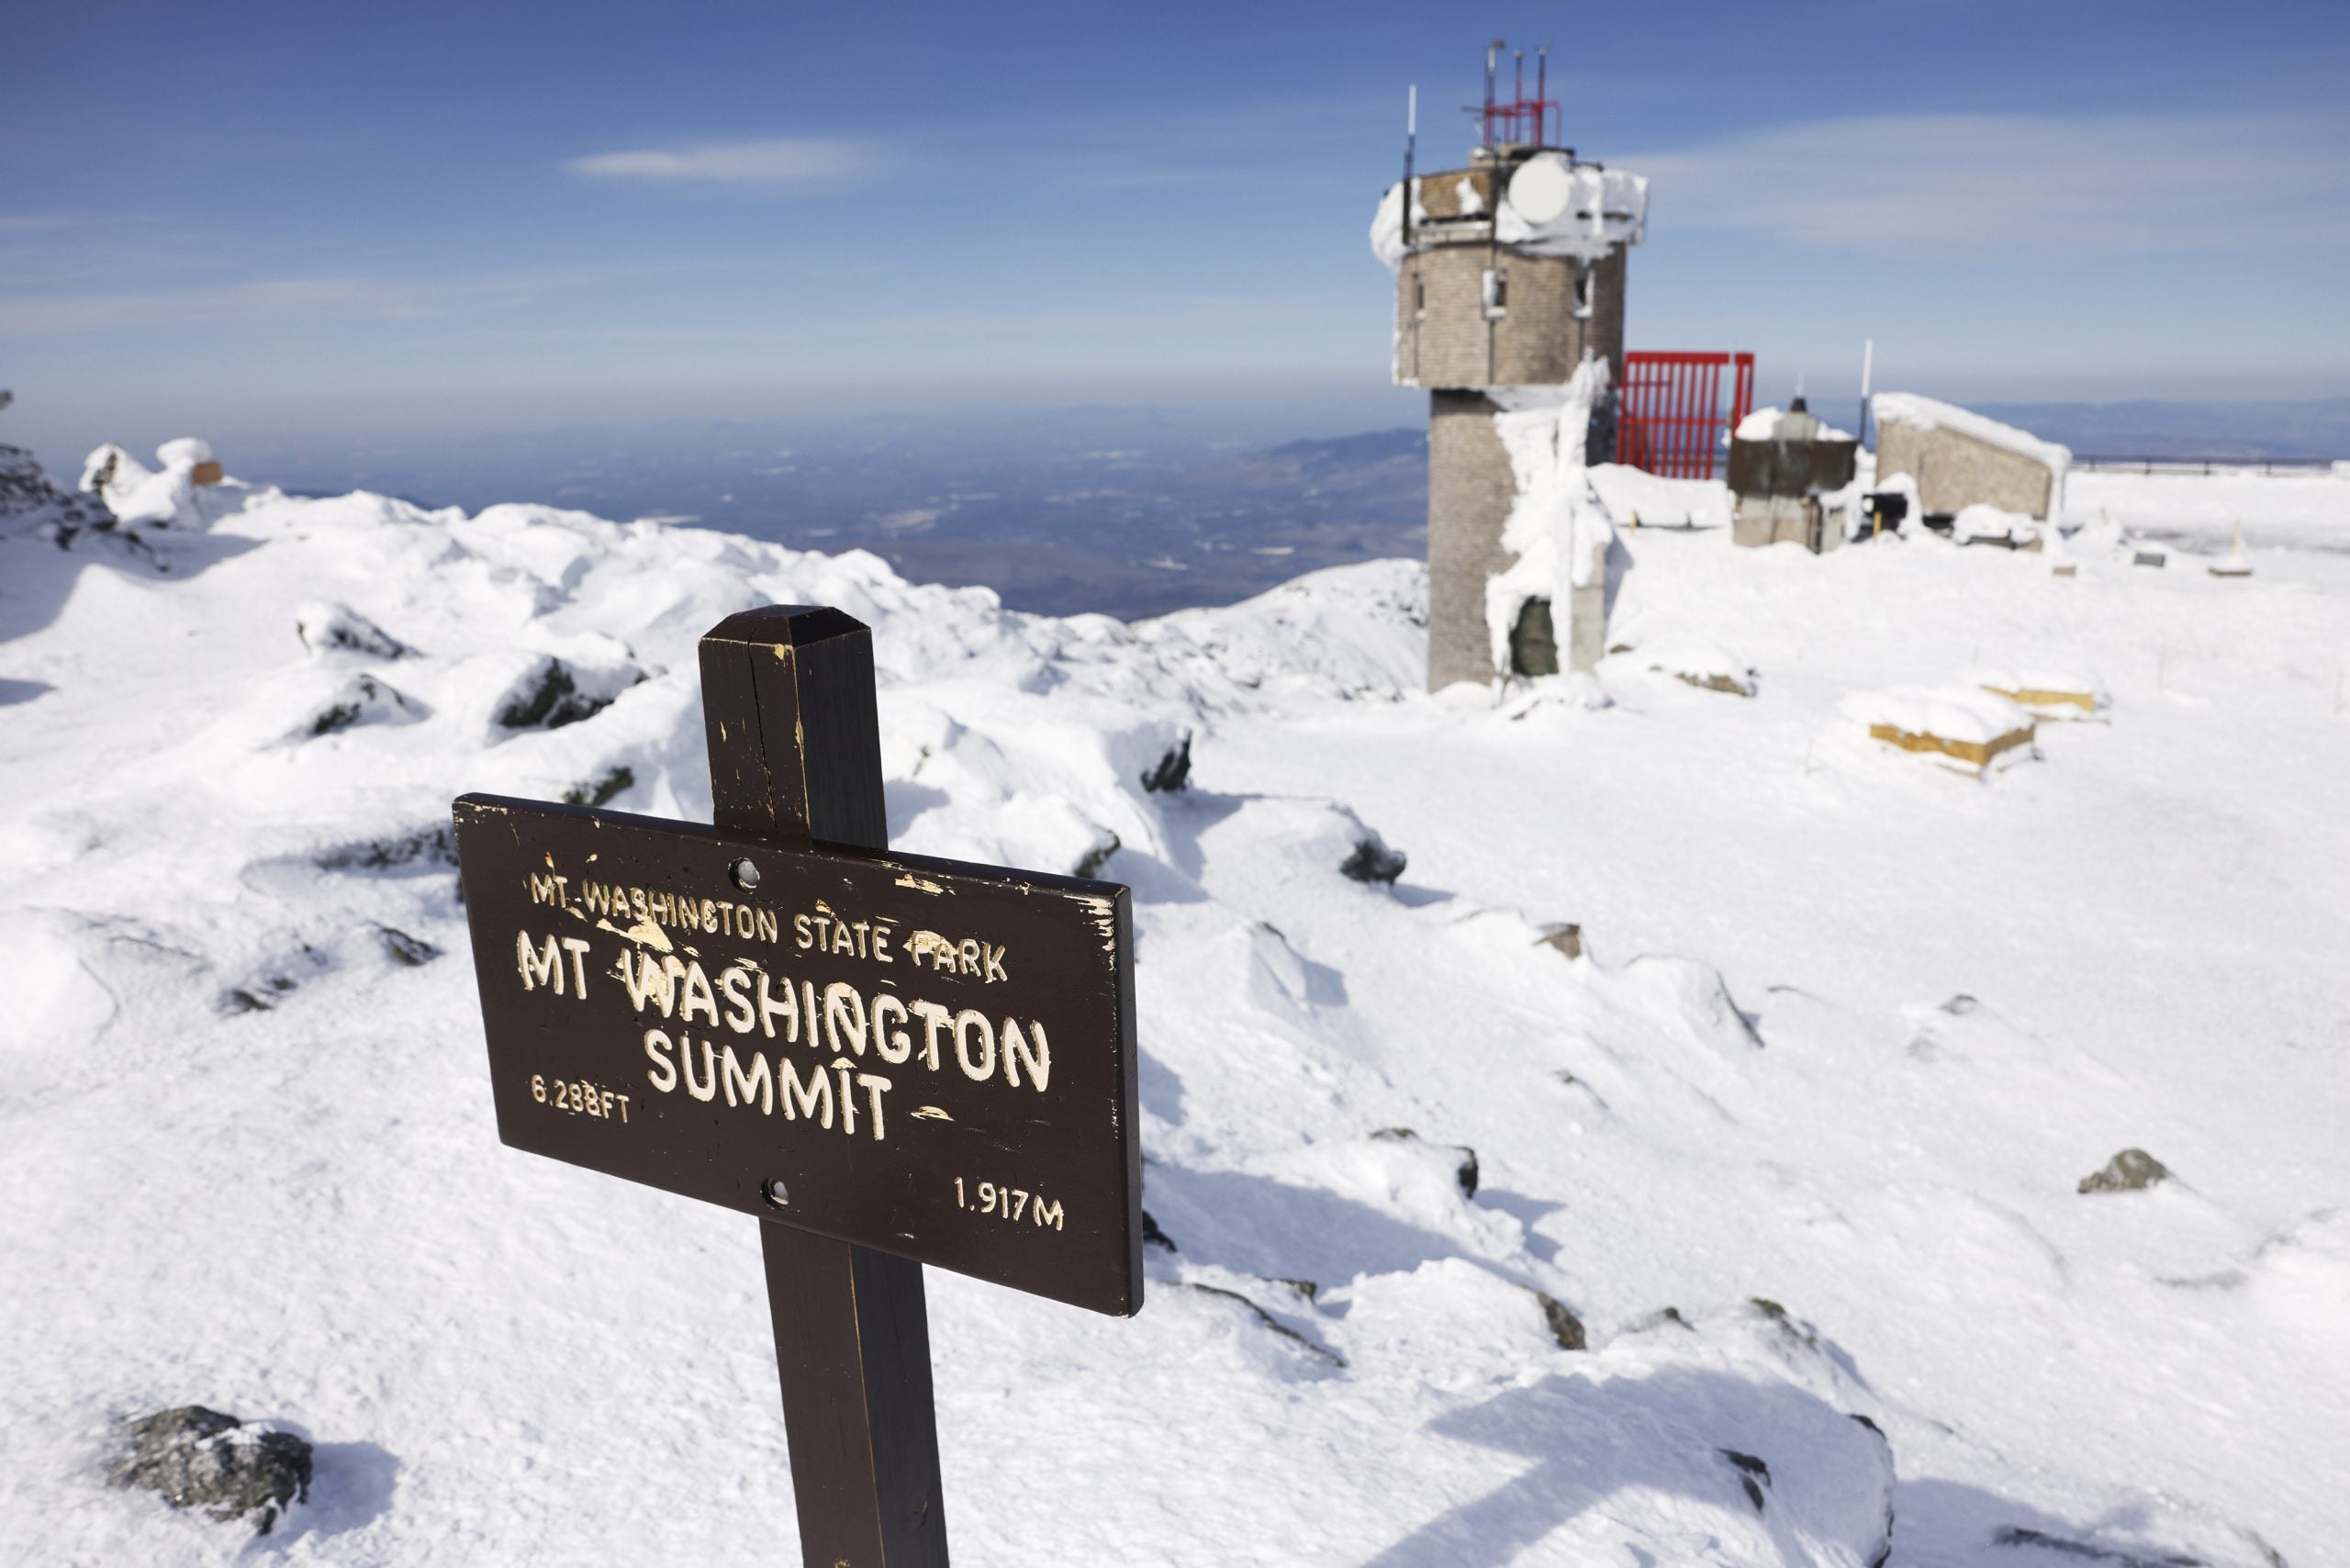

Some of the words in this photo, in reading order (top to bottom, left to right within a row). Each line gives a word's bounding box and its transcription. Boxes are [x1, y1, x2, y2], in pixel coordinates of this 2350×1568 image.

[582, 879, 778, 943] WASHINGTON
[794, 913, 893, 963] STATE
[905, 930, 1008, 983] PARK
[517, 929, 590, 1001] MT
[620, 946, 1051, 1092] WASHINGTON
[643, 1028, 892, 1140] SUMMIT
